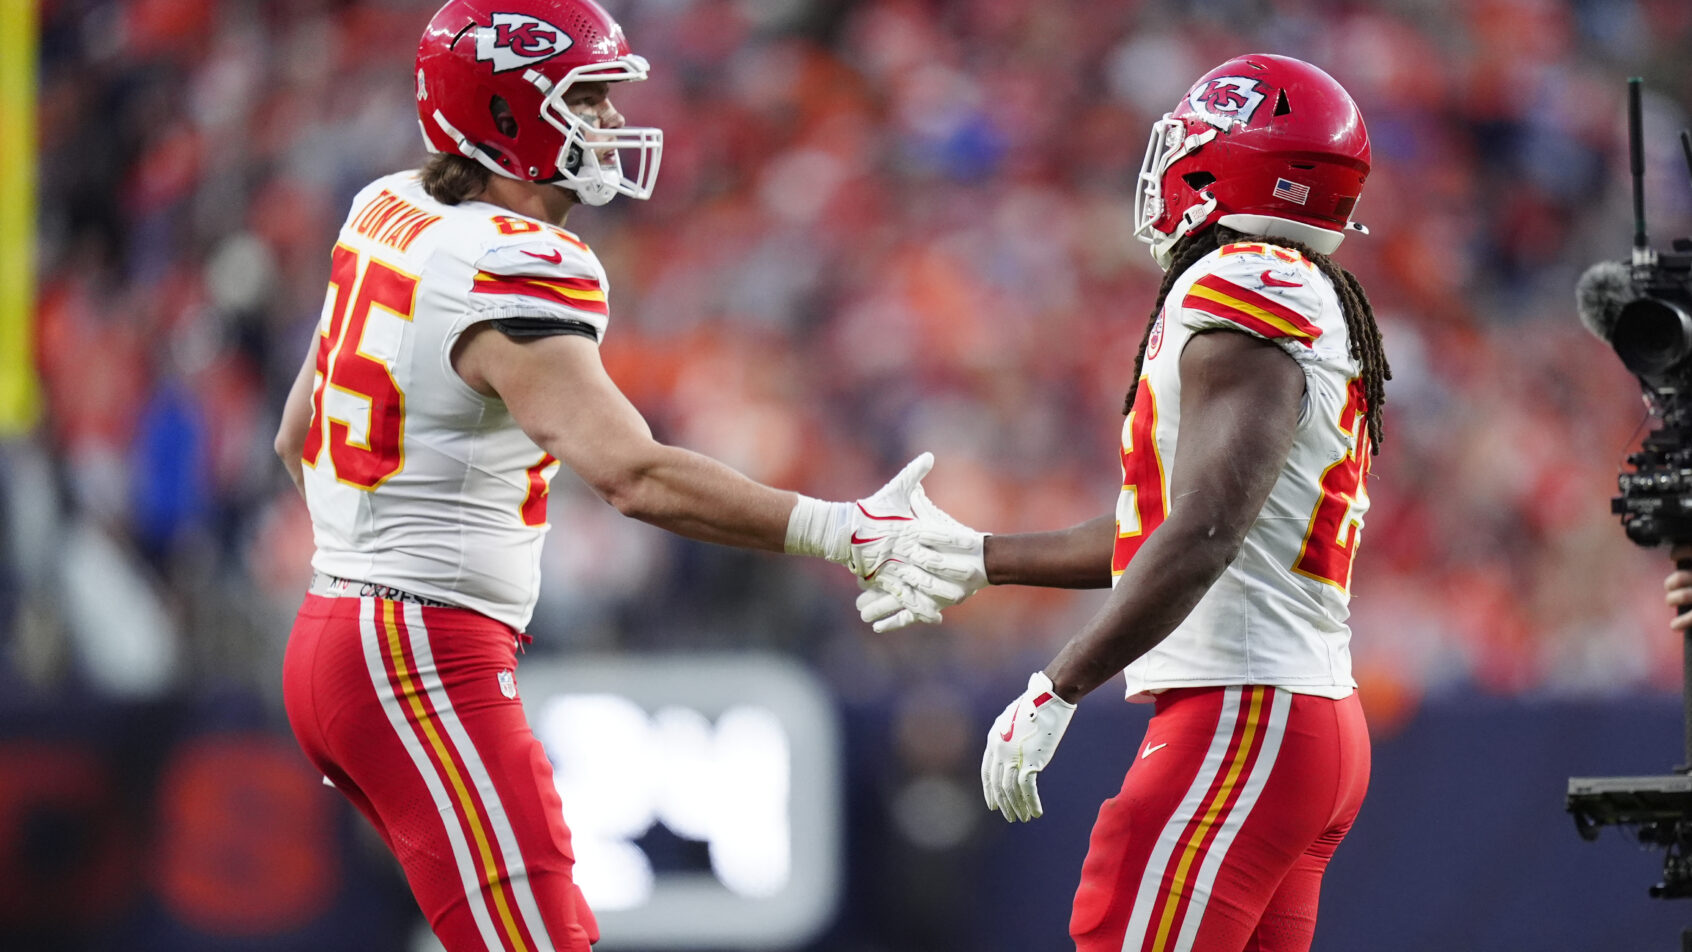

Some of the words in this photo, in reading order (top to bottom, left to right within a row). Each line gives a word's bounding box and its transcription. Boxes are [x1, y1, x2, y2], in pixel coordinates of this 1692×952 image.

[494, 22, 556, 57] KC
[1196, 80, 1248, 116] KC
[350, 188, 442, 252] TONYAN
